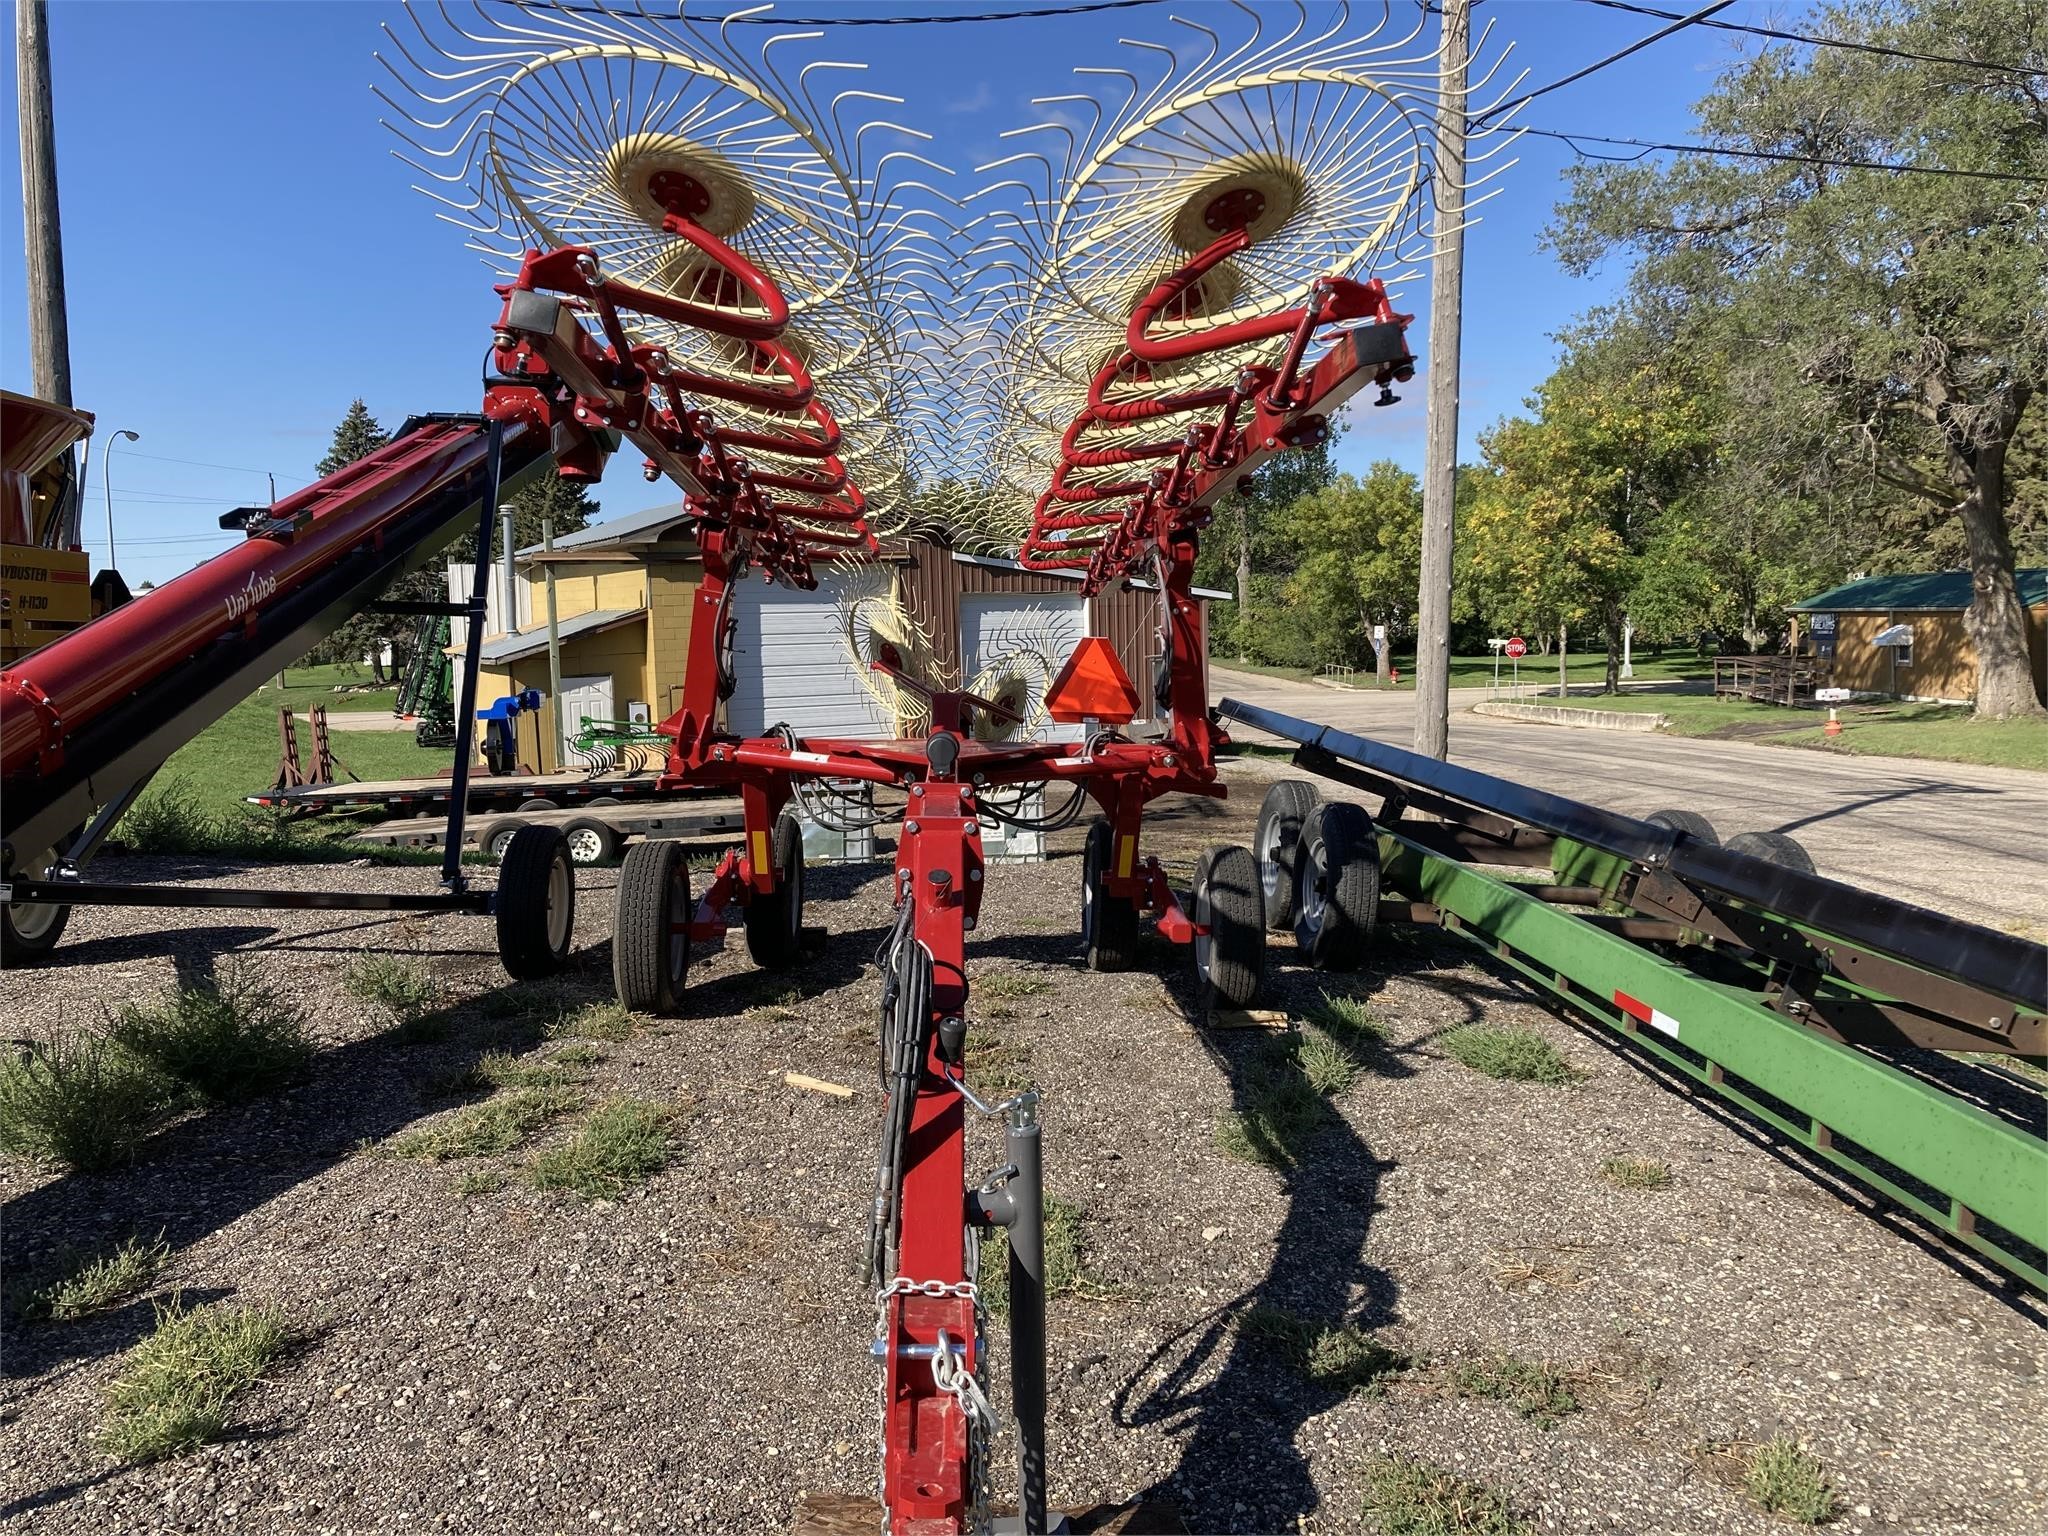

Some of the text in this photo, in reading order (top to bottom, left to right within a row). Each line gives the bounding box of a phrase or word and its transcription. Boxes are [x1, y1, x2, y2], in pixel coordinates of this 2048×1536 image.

[19, 594, 48, 610] H-1130
[224, 570, 277, 621] UniTube
[1507, 644, 1525, 653] STOP
